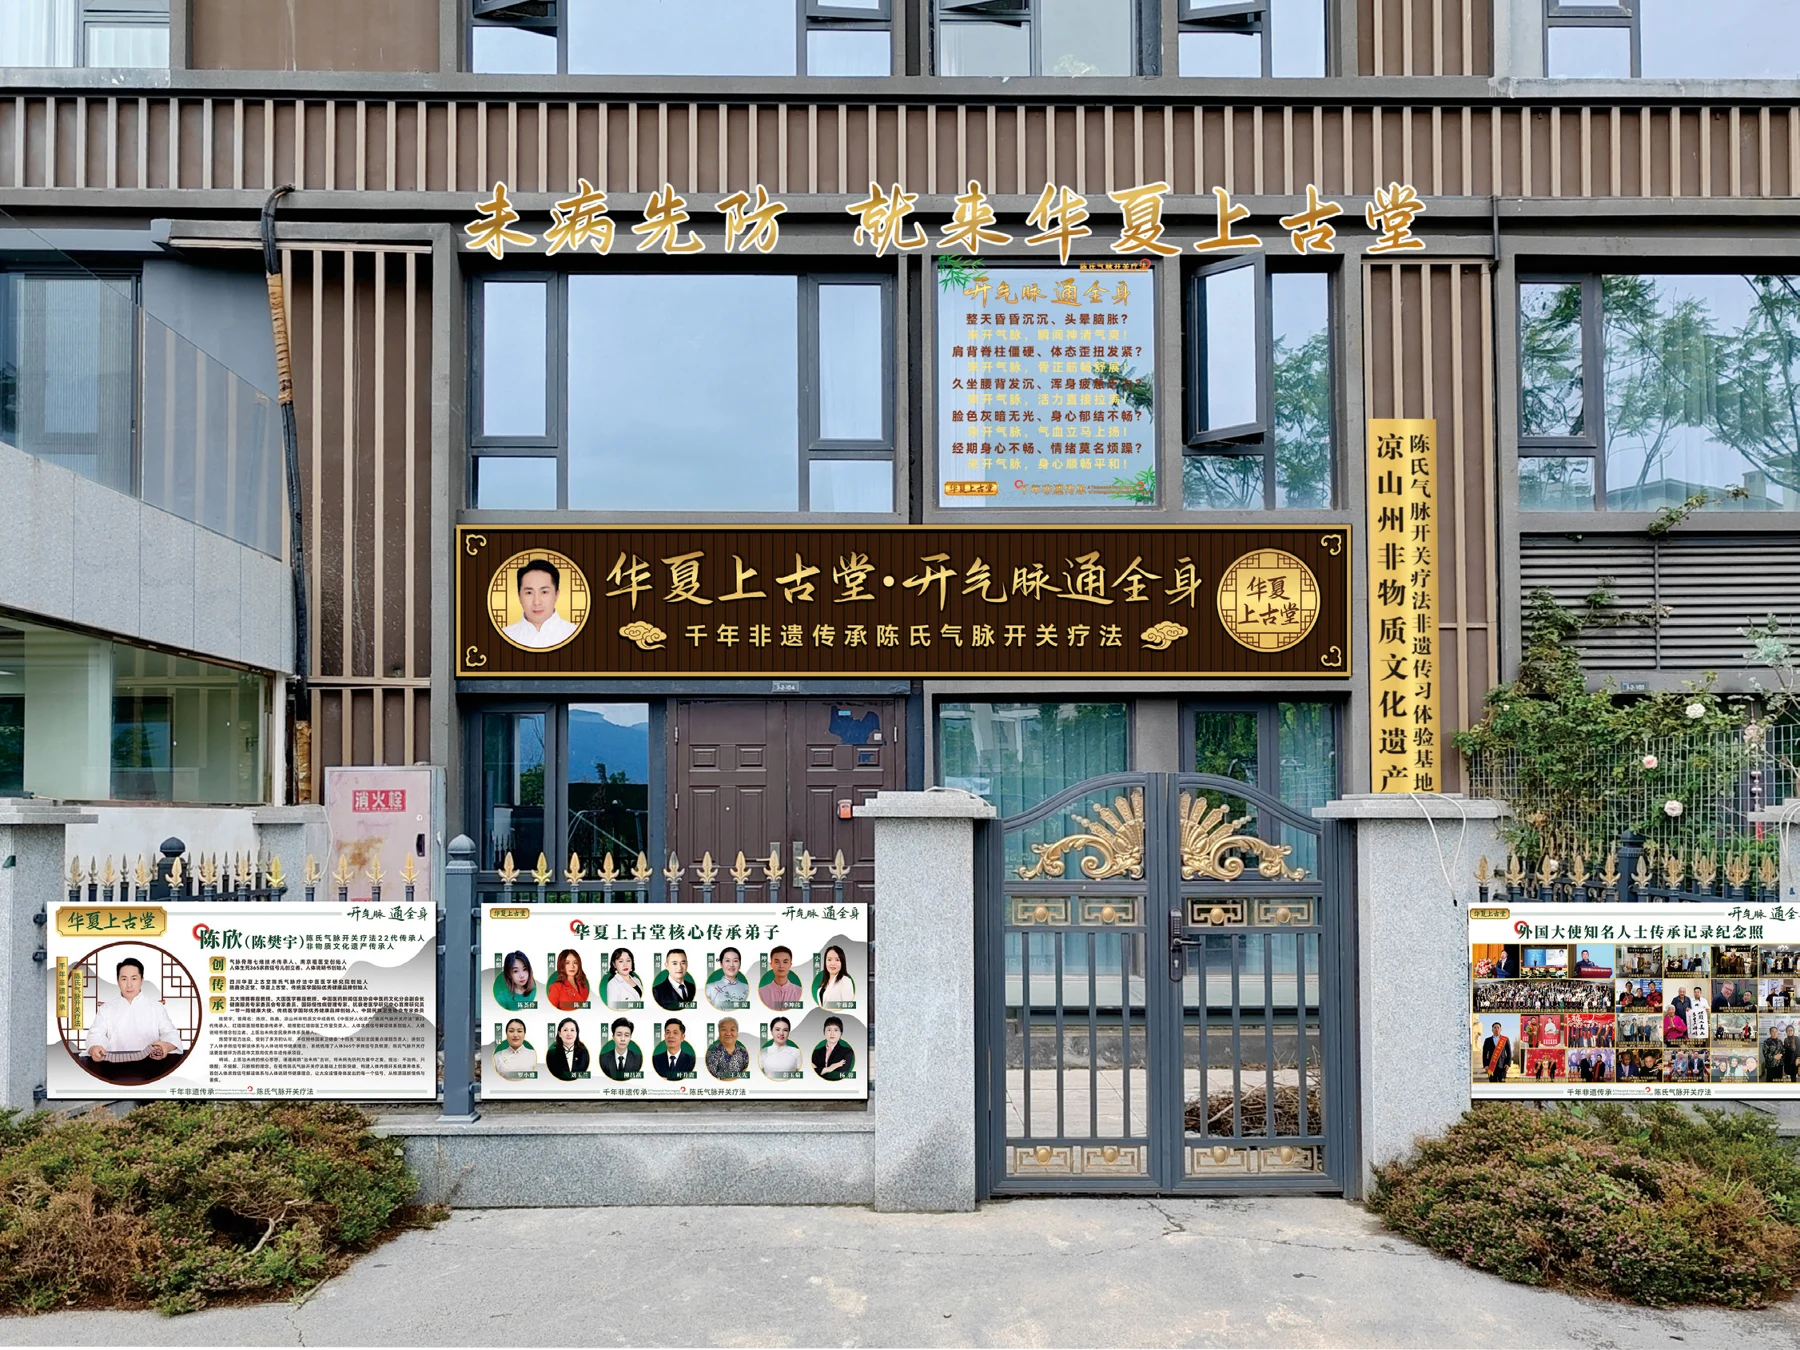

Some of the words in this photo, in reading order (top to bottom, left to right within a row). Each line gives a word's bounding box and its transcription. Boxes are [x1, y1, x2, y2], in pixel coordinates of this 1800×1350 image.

[466, 182, 788, 259] 未病先防
[846, 180, 1428, 266] 就来华夏上古堂
[1246, 576, 1291, 602] 华夏
[1238, 602, 1300, 625] 上古堂
[1377, 433, 1408, 792] 凉山州非物质文化遗产
[1410, 434, 1434, 791] 陈氏气脉开关疗法非遗传习体验基地
[685, 624, 1123, 647] 千年非遗传承陈氏气脉开关疗法
[355, 791, 403, 808] 消火栓
[494, 909, 527, 918] 华夏上古堂
[1474, 910, 1507, 918] 华夏上古堂
[67, 911, 156, 932] 华夏上古堂
[306, 934, 425, 942] 陈氏气脉开关疗法22代传承人
[573, 923, 780, 941] 华夏上古堂核心传承弟子
[1519, 924, 1764, 939] 外国大使知名人士传承记录纪念照
[212, 958, 224, 971] 创
[212, 978, 224, 991] 传
[211, 998, 225, 1011] 承
[256, 1088, 314, 1096] 陈氏气脉开关疗法
[603, 1088, 647, 1096] 千年非遗传承
[690, 1088, 746, 1096] 陈氏气脉开关疗法
[1567, 1088, 1612, 1096] 千年非遗传承
[1654, 1088, 1711, 1096] 陈氏气脉开关疗法
